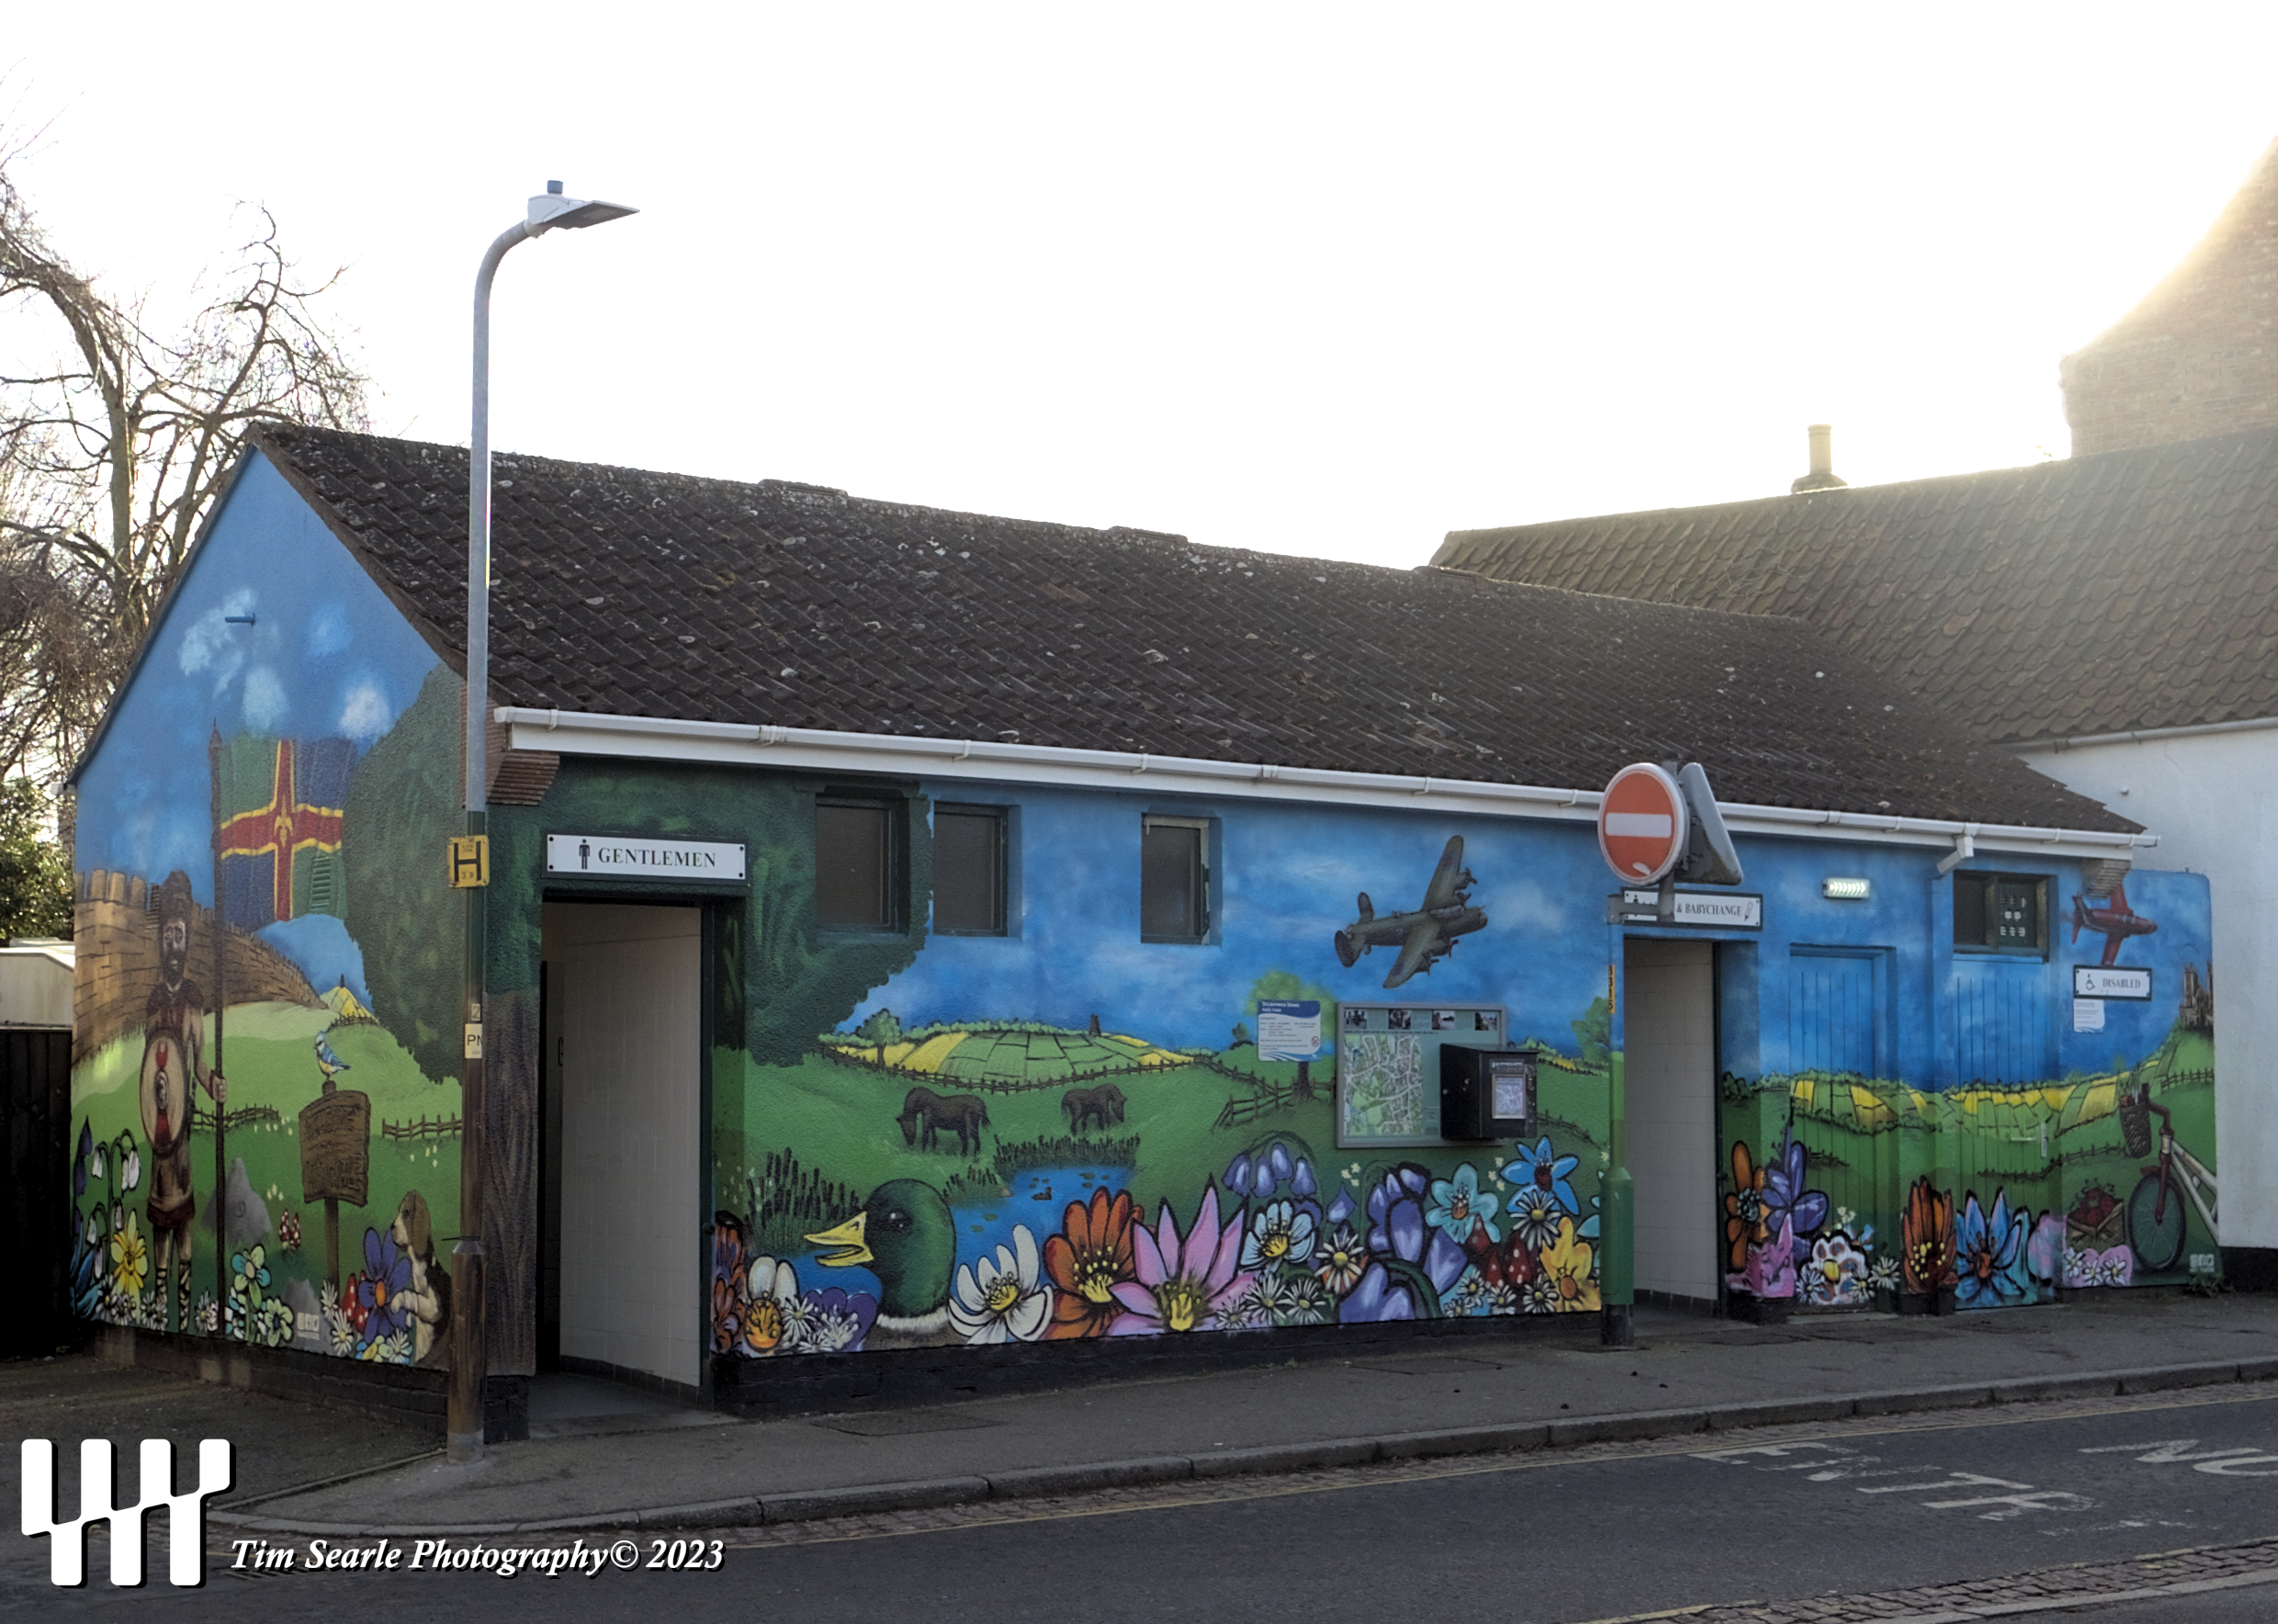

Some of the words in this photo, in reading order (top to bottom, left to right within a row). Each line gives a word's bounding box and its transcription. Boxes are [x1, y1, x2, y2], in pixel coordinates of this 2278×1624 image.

[453, 840, 482, 882] H
[598, 847, 716, 868] GENTLEMEN
[1685, 904, 1742, 917] BABYCHANGE
[2103, 978, 2141, 989] DISABLED
